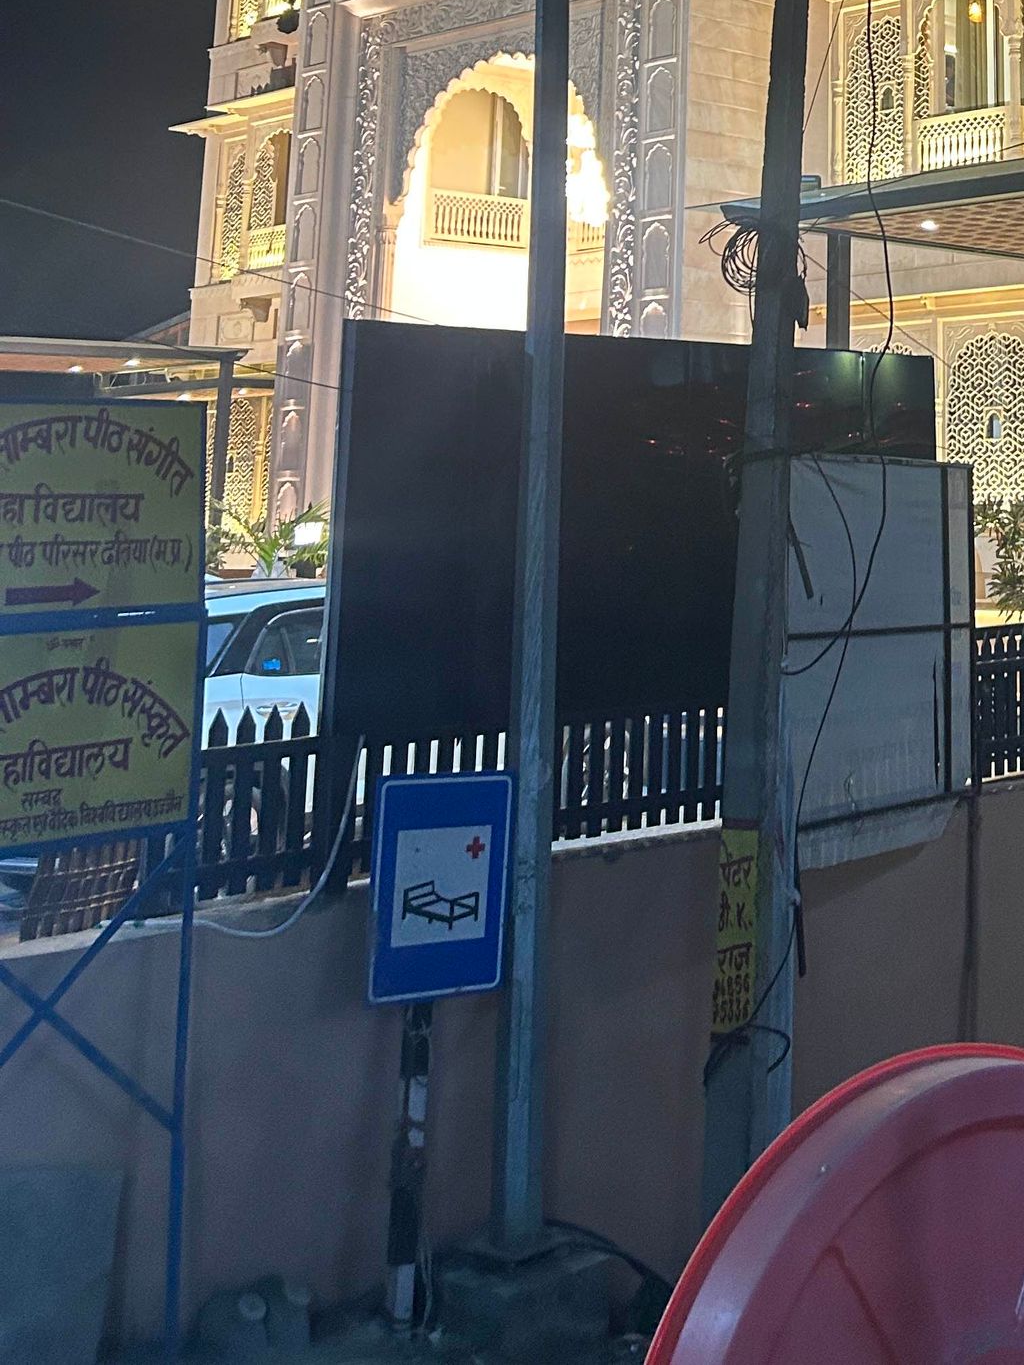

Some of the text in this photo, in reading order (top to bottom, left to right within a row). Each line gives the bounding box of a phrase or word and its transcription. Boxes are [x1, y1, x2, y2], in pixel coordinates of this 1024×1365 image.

[83, 407, 130, 453] पीठ
[127, 426, 194, 497] संगीत
[83, 656, 127, 706] पीठ
[122, 677, 190, 759] संस्कृत
